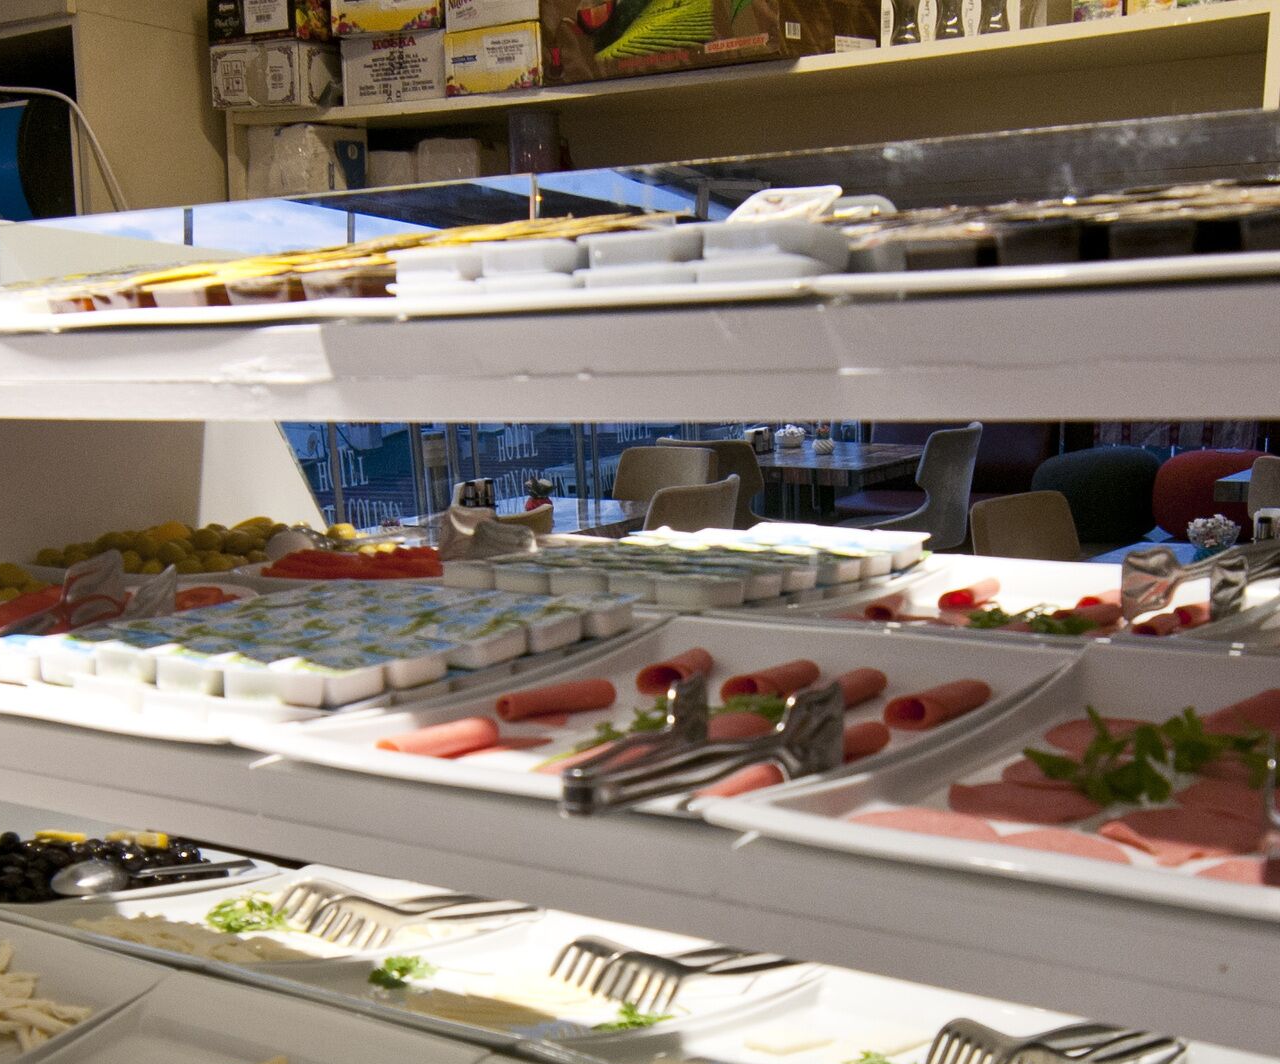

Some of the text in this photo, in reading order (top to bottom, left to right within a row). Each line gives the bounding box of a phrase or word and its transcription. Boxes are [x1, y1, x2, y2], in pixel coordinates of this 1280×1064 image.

[372, 36, 416, 50] KOSKA
[496, 421, 539, 462] HOTEL
[316, 446, 368, 492] HOTEL
